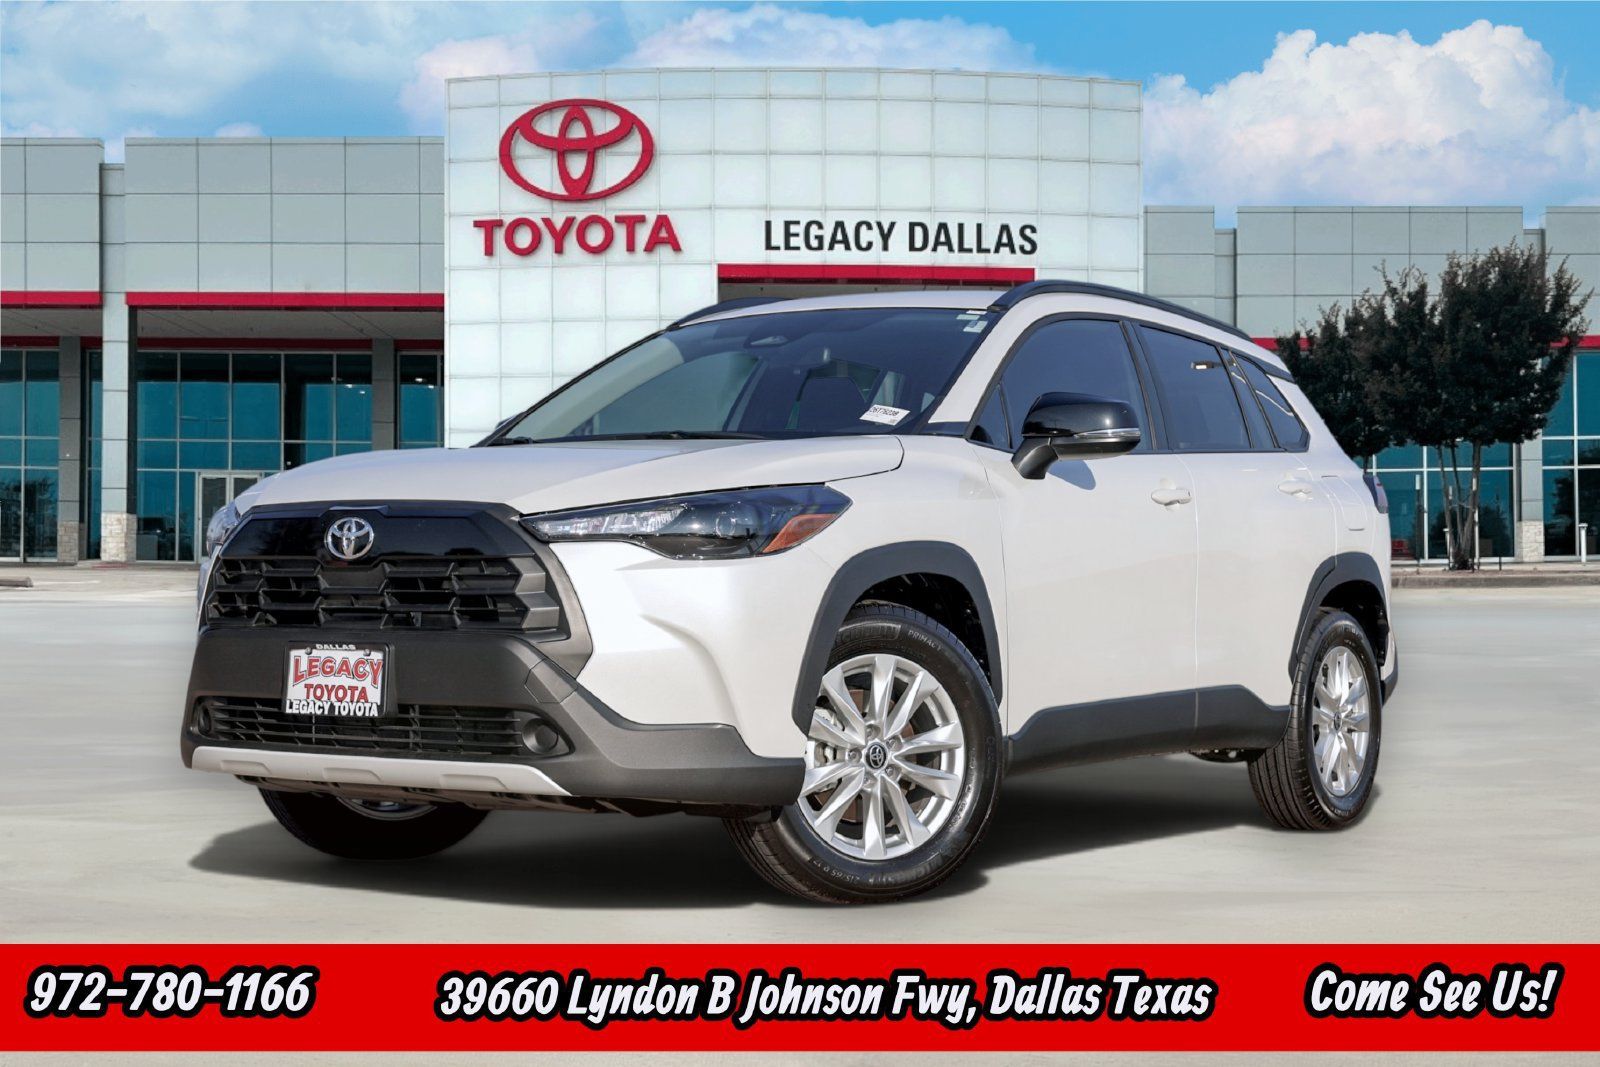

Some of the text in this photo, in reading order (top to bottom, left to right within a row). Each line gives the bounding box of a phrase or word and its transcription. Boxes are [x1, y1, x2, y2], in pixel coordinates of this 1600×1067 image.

[473, 214, 682, 257] TOYOTA
[764, 219, 1039, 255] LEGACY DALLAS
[315, 643, 356, 651] DALLAS
[292, 656, 383, 689] LEGACY
[304, 683, 369, 704] TOYOTA
[285, 699, 379, 717] LEGACY TOYOTA
